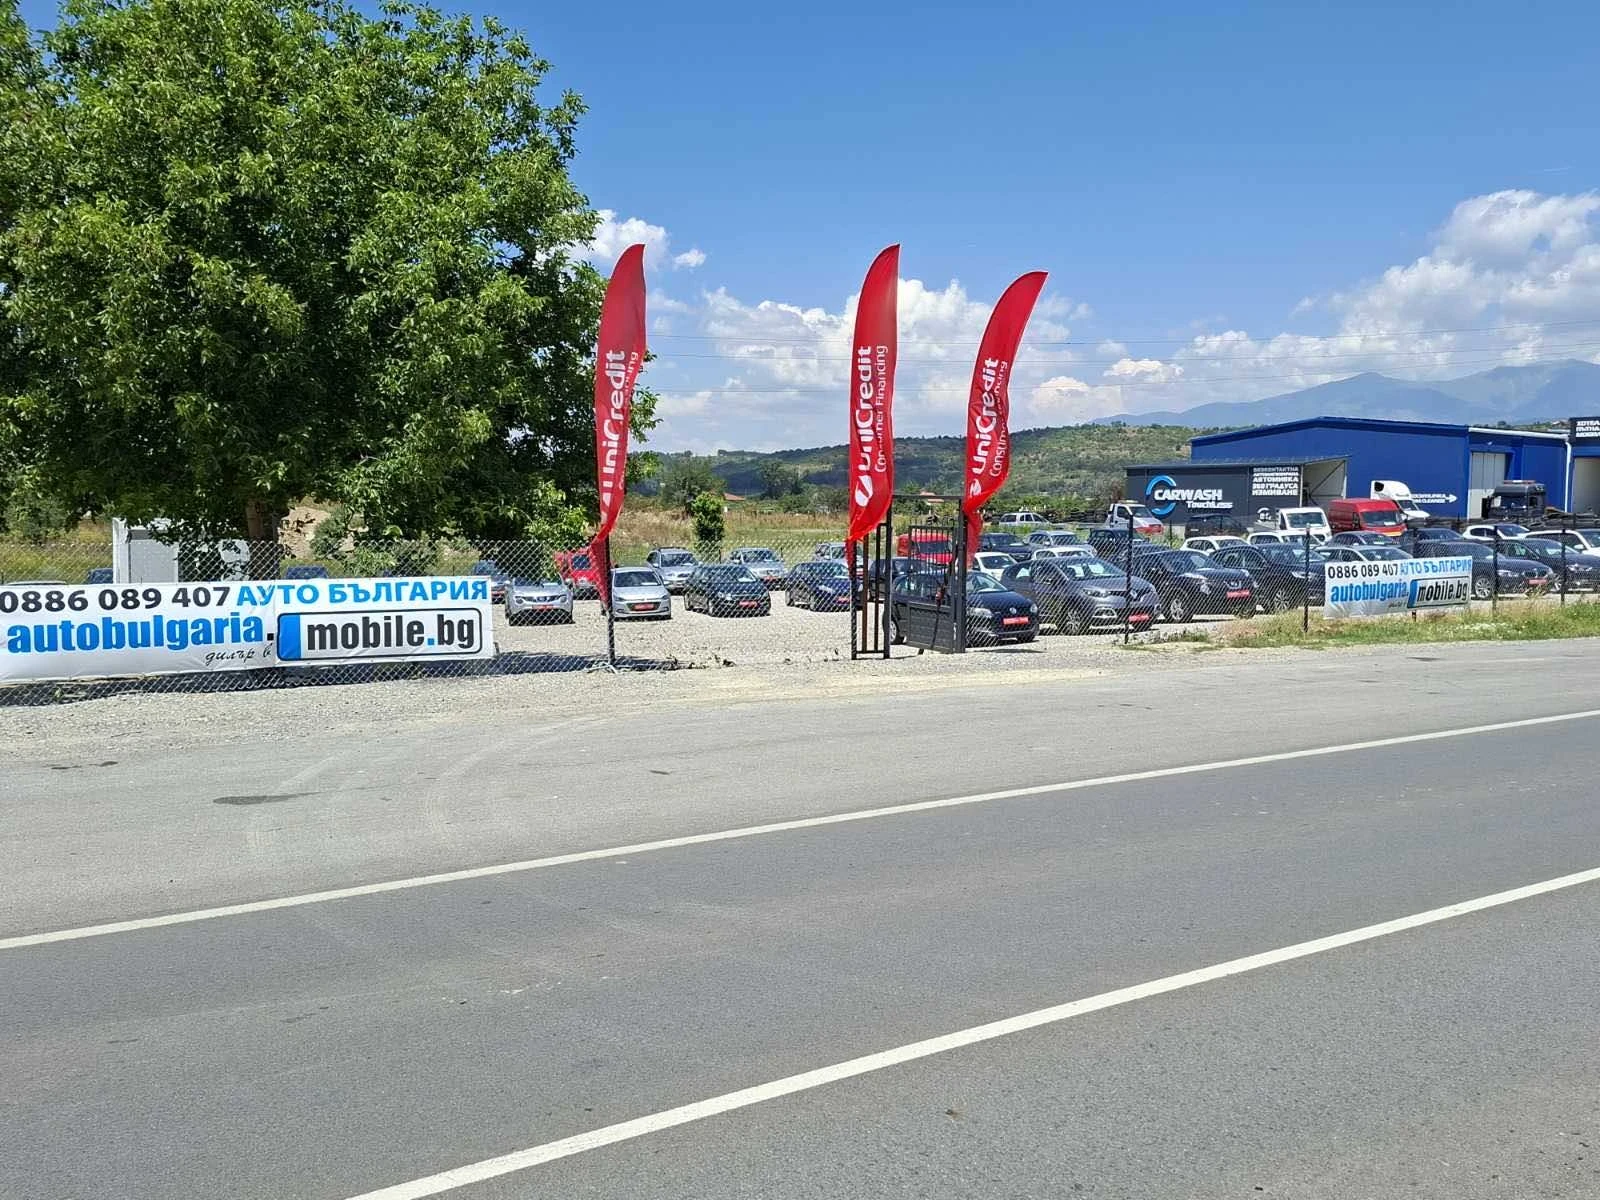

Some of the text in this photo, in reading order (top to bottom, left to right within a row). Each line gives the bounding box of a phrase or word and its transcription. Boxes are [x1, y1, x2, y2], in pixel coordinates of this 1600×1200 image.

[972, 357, 999, 475] UniCredit
[1154, 489, 1223, 501] CARWASH
[1327, 563, 1358, 578] 0886
[1360, 563, 1380, 576] 089
[1382, 563, 1399, 576] 407
[0, 581, 488, 613] 0886 089 407 АУТО БЪЛГАРИЯ
[1417, 578, 1468, 602] mobile.bg
[307, 614, 474, 650] mobile.bg
